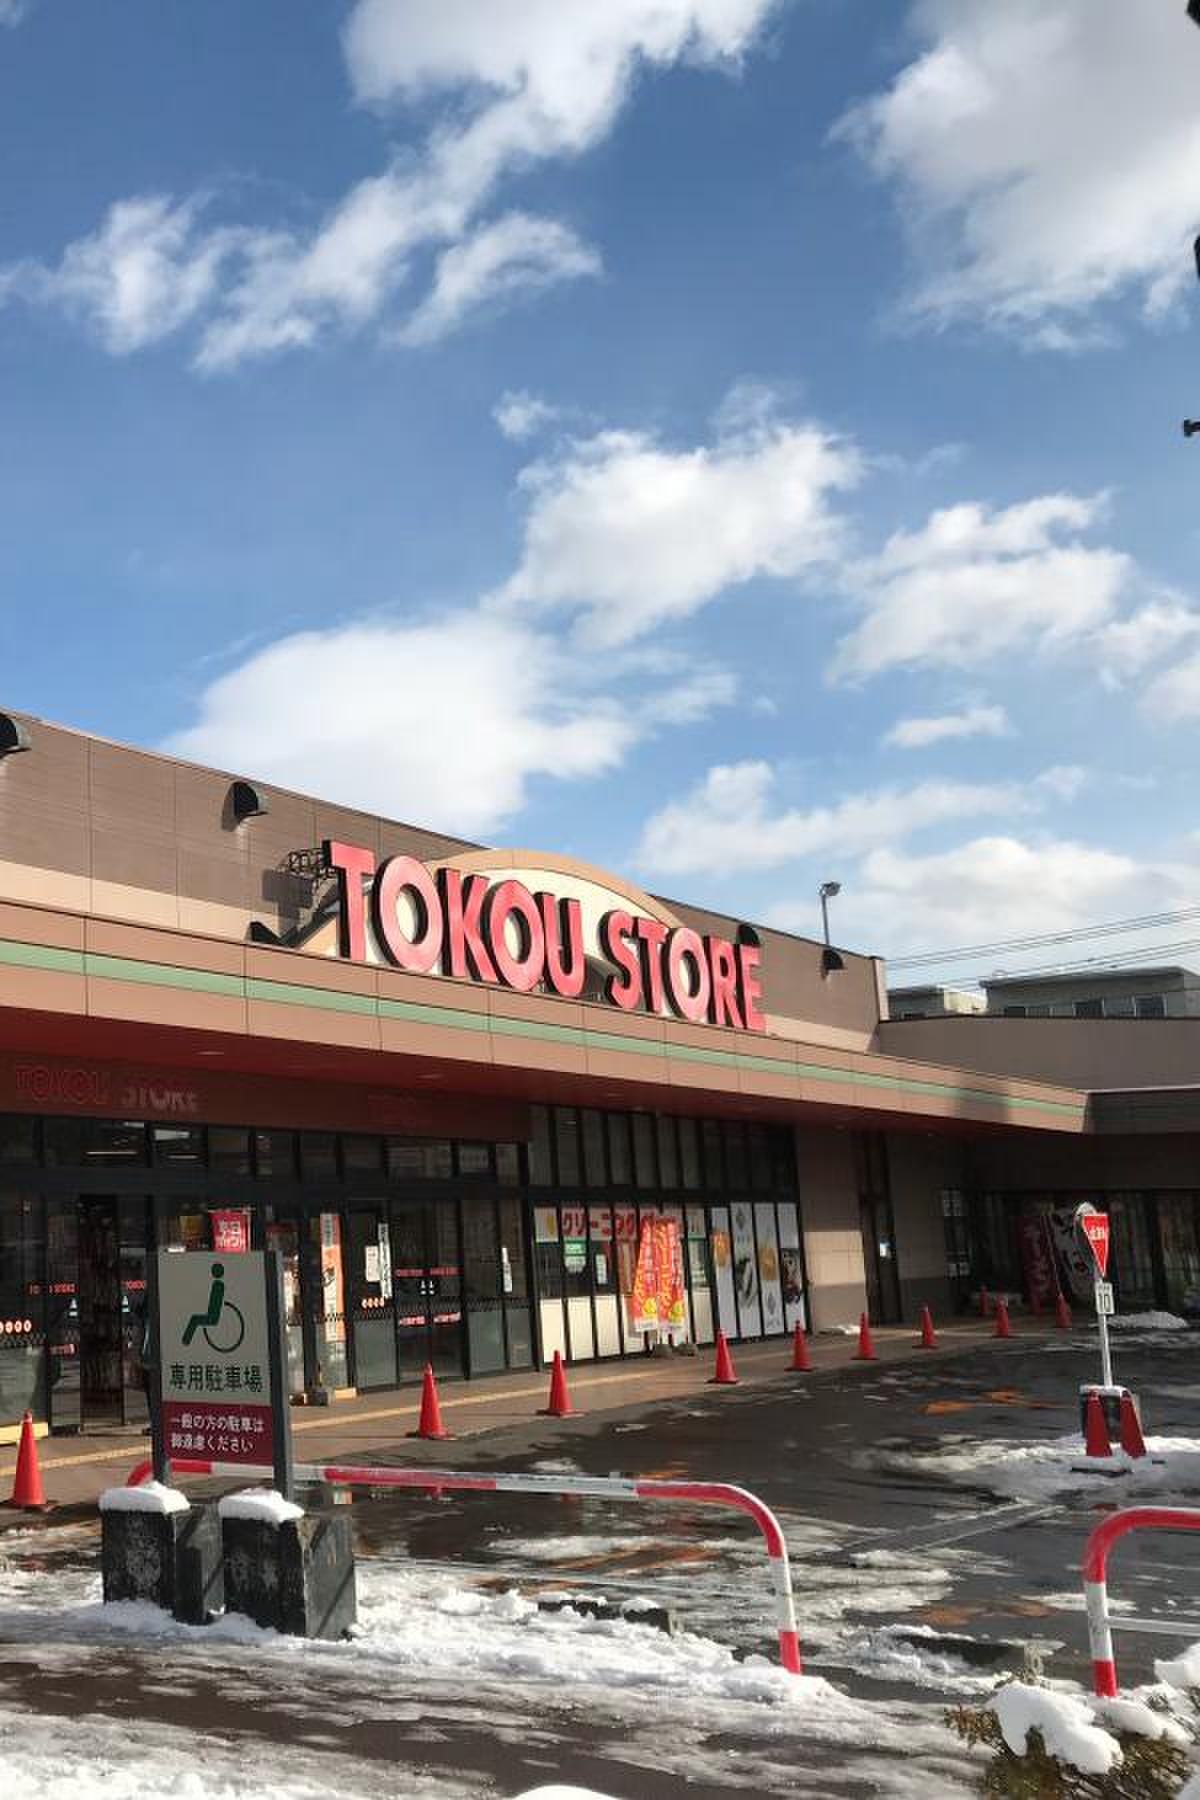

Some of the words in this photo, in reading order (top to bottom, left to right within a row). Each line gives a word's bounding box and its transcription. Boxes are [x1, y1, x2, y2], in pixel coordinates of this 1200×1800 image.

[324, 840, 585, 997] TOKOU
[600, 909, 766, 1033] STORE
[169, 1362, 263, 1392] 専用駐車場
[169, 1413, 265, 1432] 一般の方の駐車は
